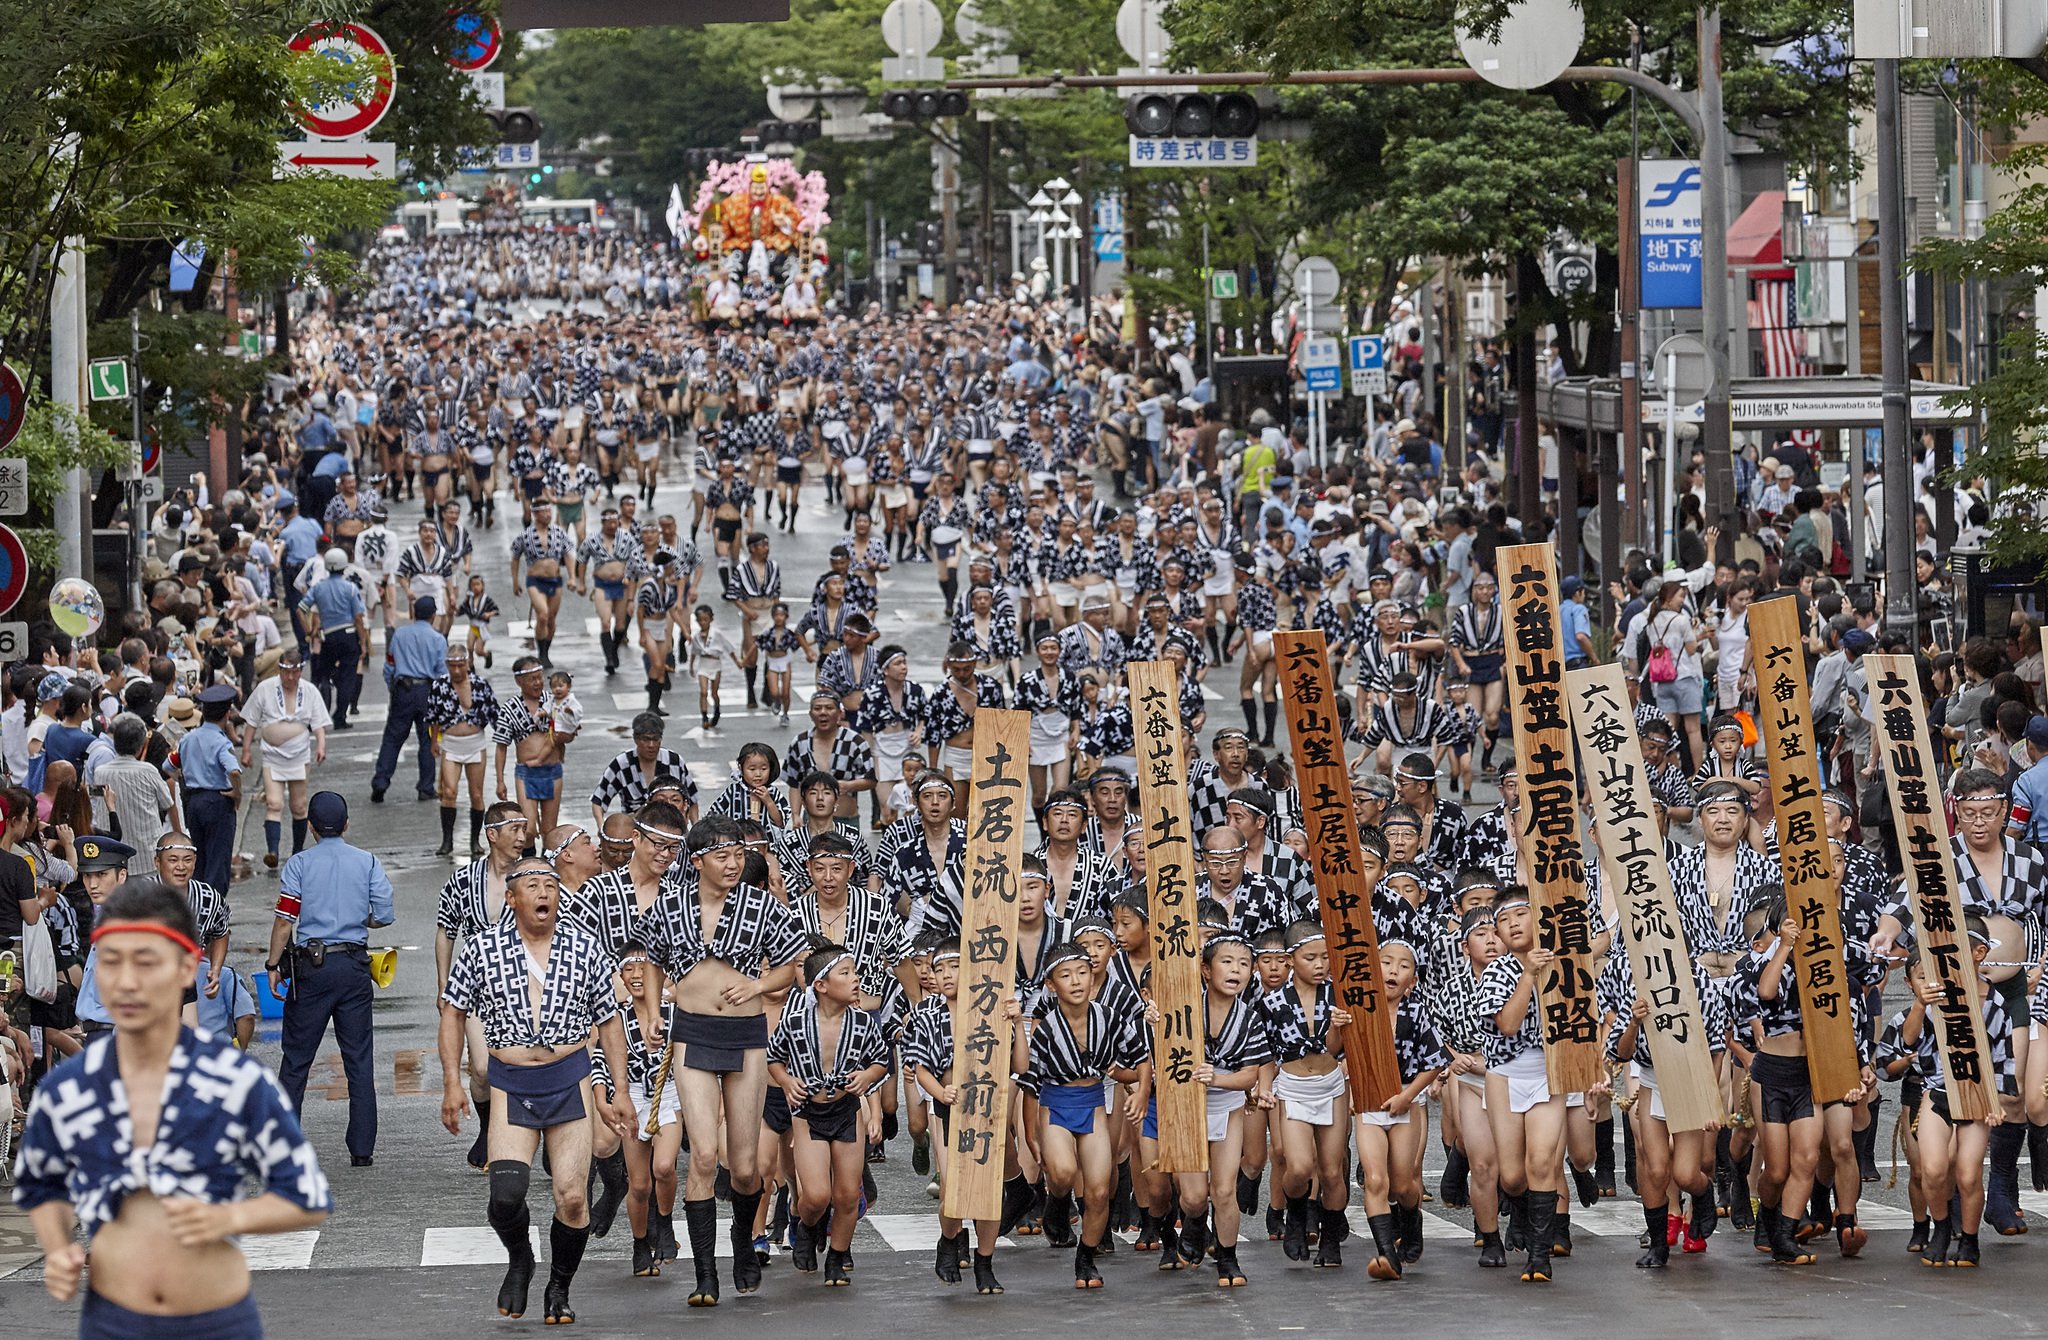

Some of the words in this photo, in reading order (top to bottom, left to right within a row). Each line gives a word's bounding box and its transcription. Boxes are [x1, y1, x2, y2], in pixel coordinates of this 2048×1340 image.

[1136, 140, 1250, 161] 時差式信号
[1645, 217, 1674, 229] 지하철
[1562, 265, 1589, 278] DVD
[1647, 261, 1691, 274] Subway
[1358, 340, 1378, 367] P
[1792, 402, 1865, 410] Nakasukawabata
[1867, 401, 1884, 409] Sta
